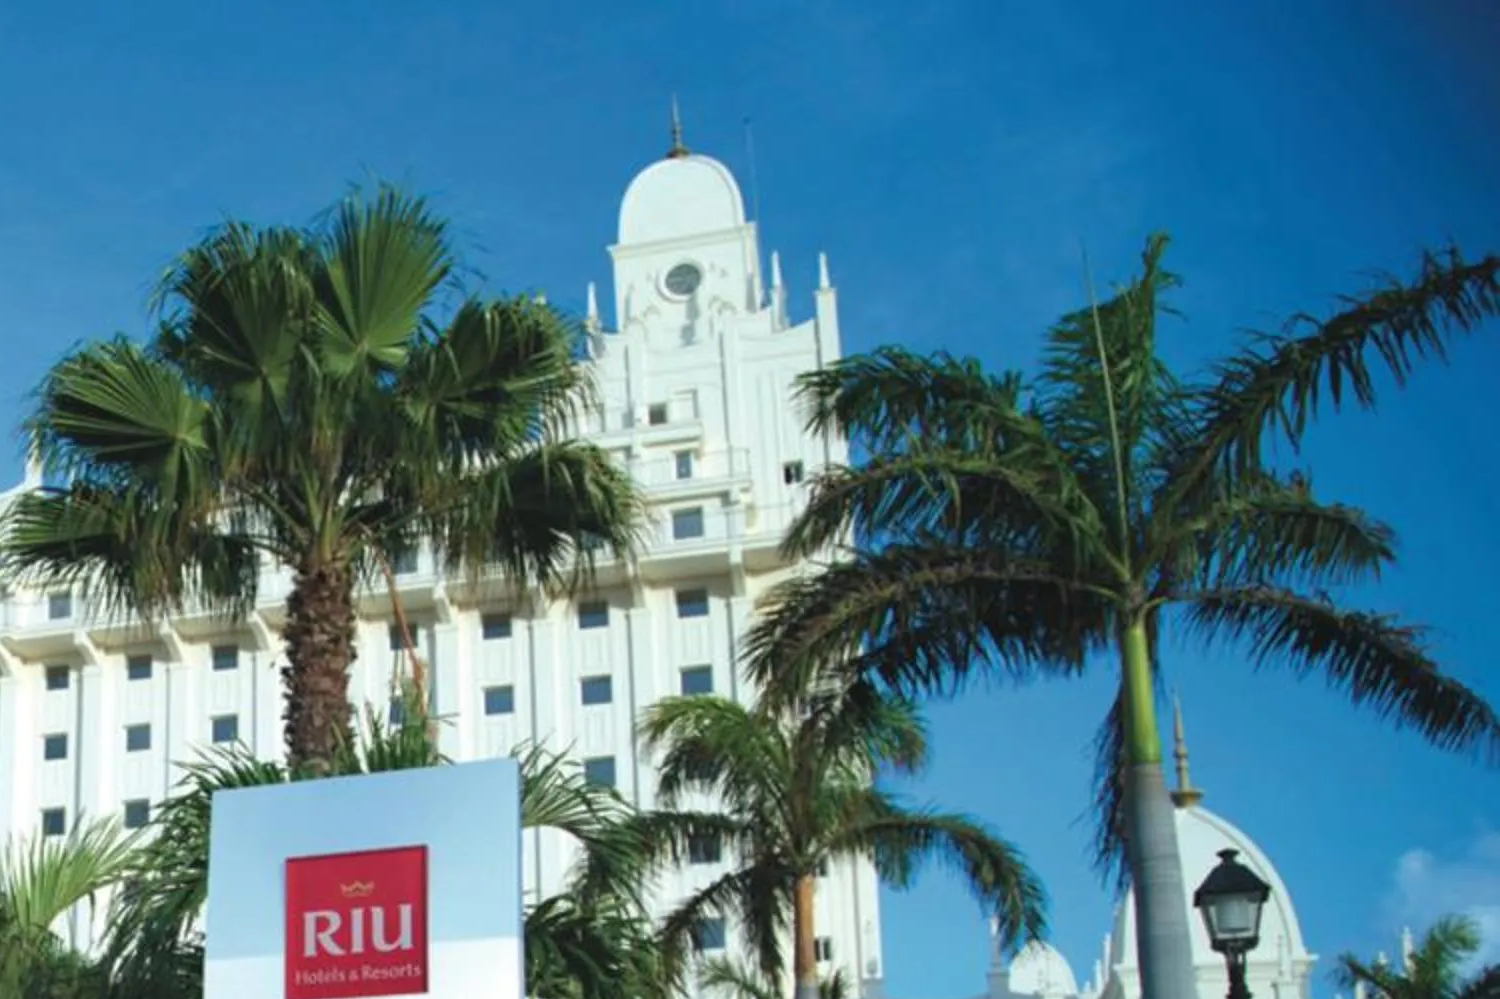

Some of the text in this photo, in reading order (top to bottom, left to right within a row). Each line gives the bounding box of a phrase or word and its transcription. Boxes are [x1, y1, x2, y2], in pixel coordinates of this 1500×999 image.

[303, 903, 414, 958] RIU
[294, 966, 346, 985] Hotels
[361, 963, 420, 981] Resorts
